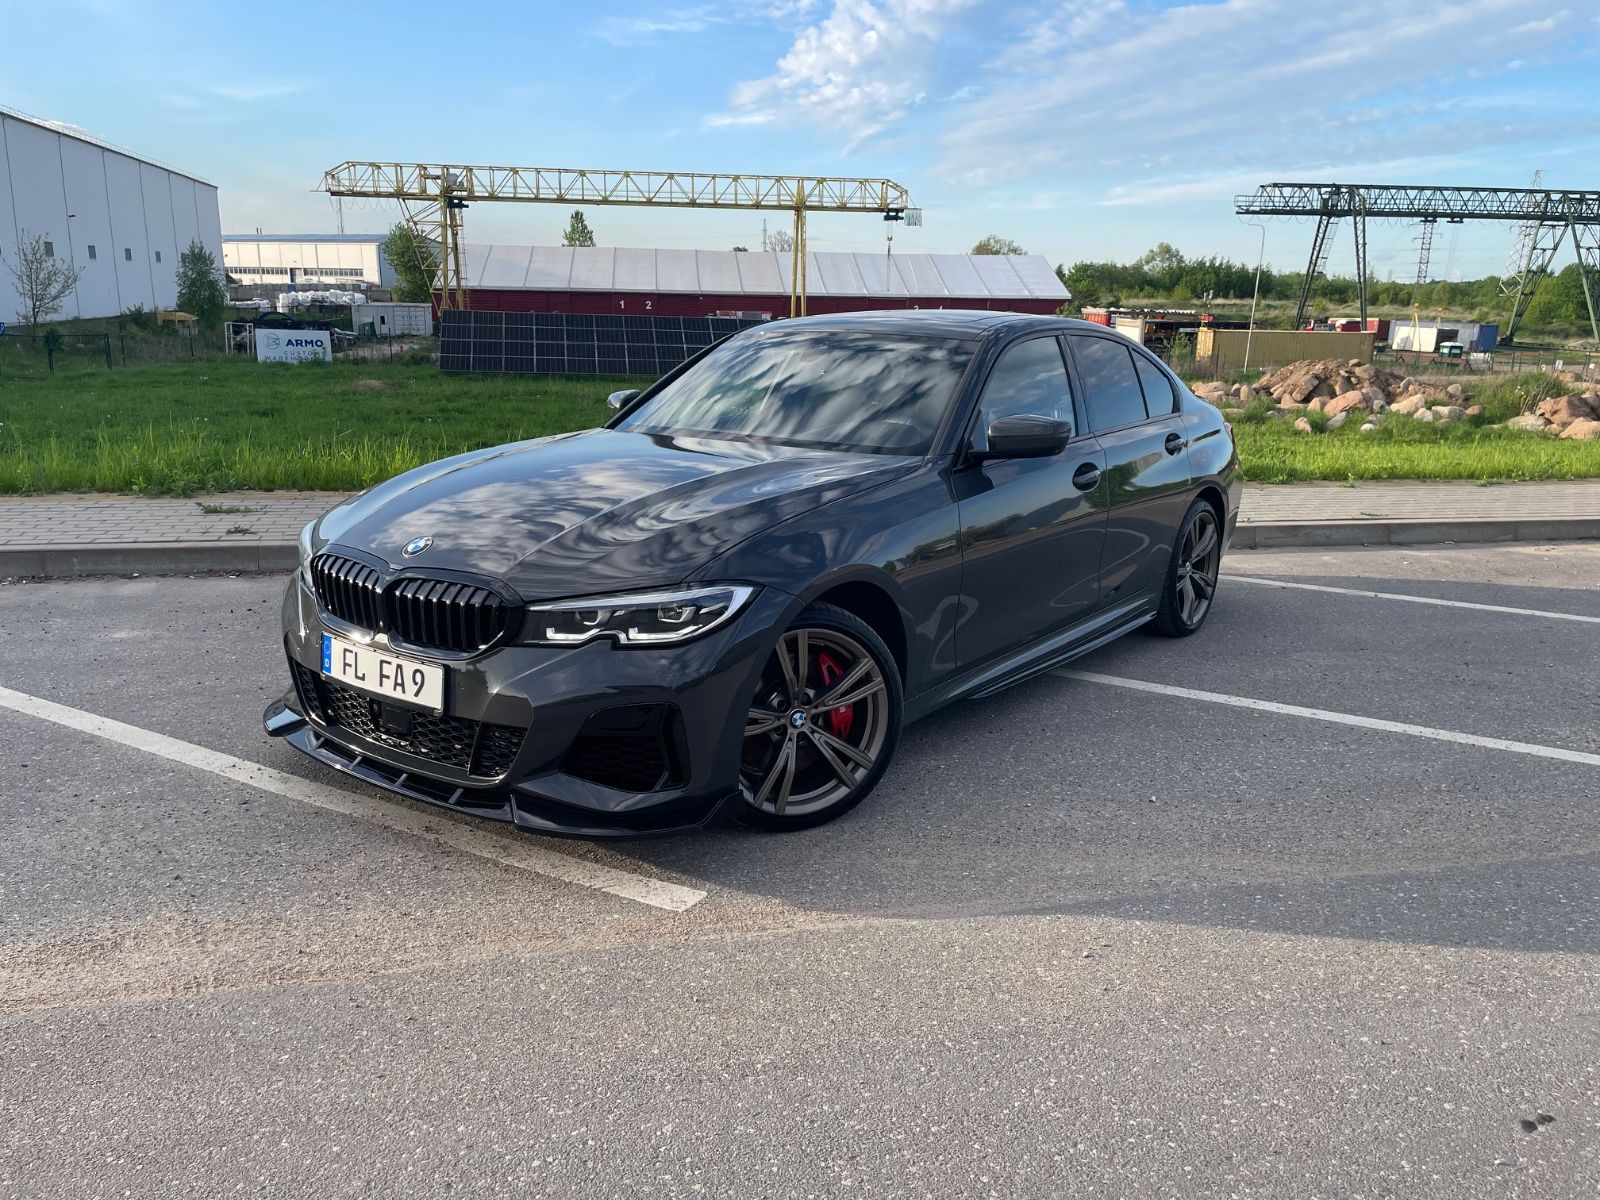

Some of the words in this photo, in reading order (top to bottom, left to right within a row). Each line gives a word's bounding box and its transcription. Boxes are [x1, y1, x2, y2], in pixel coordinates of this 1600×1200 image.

[619, 300, 625, 309] 1
[645, 300, 653, 310] 2
[286, 339, 324, 348] ARMO
[325, 659, 330, 667] D
[343, 648, 366, 681] FL
